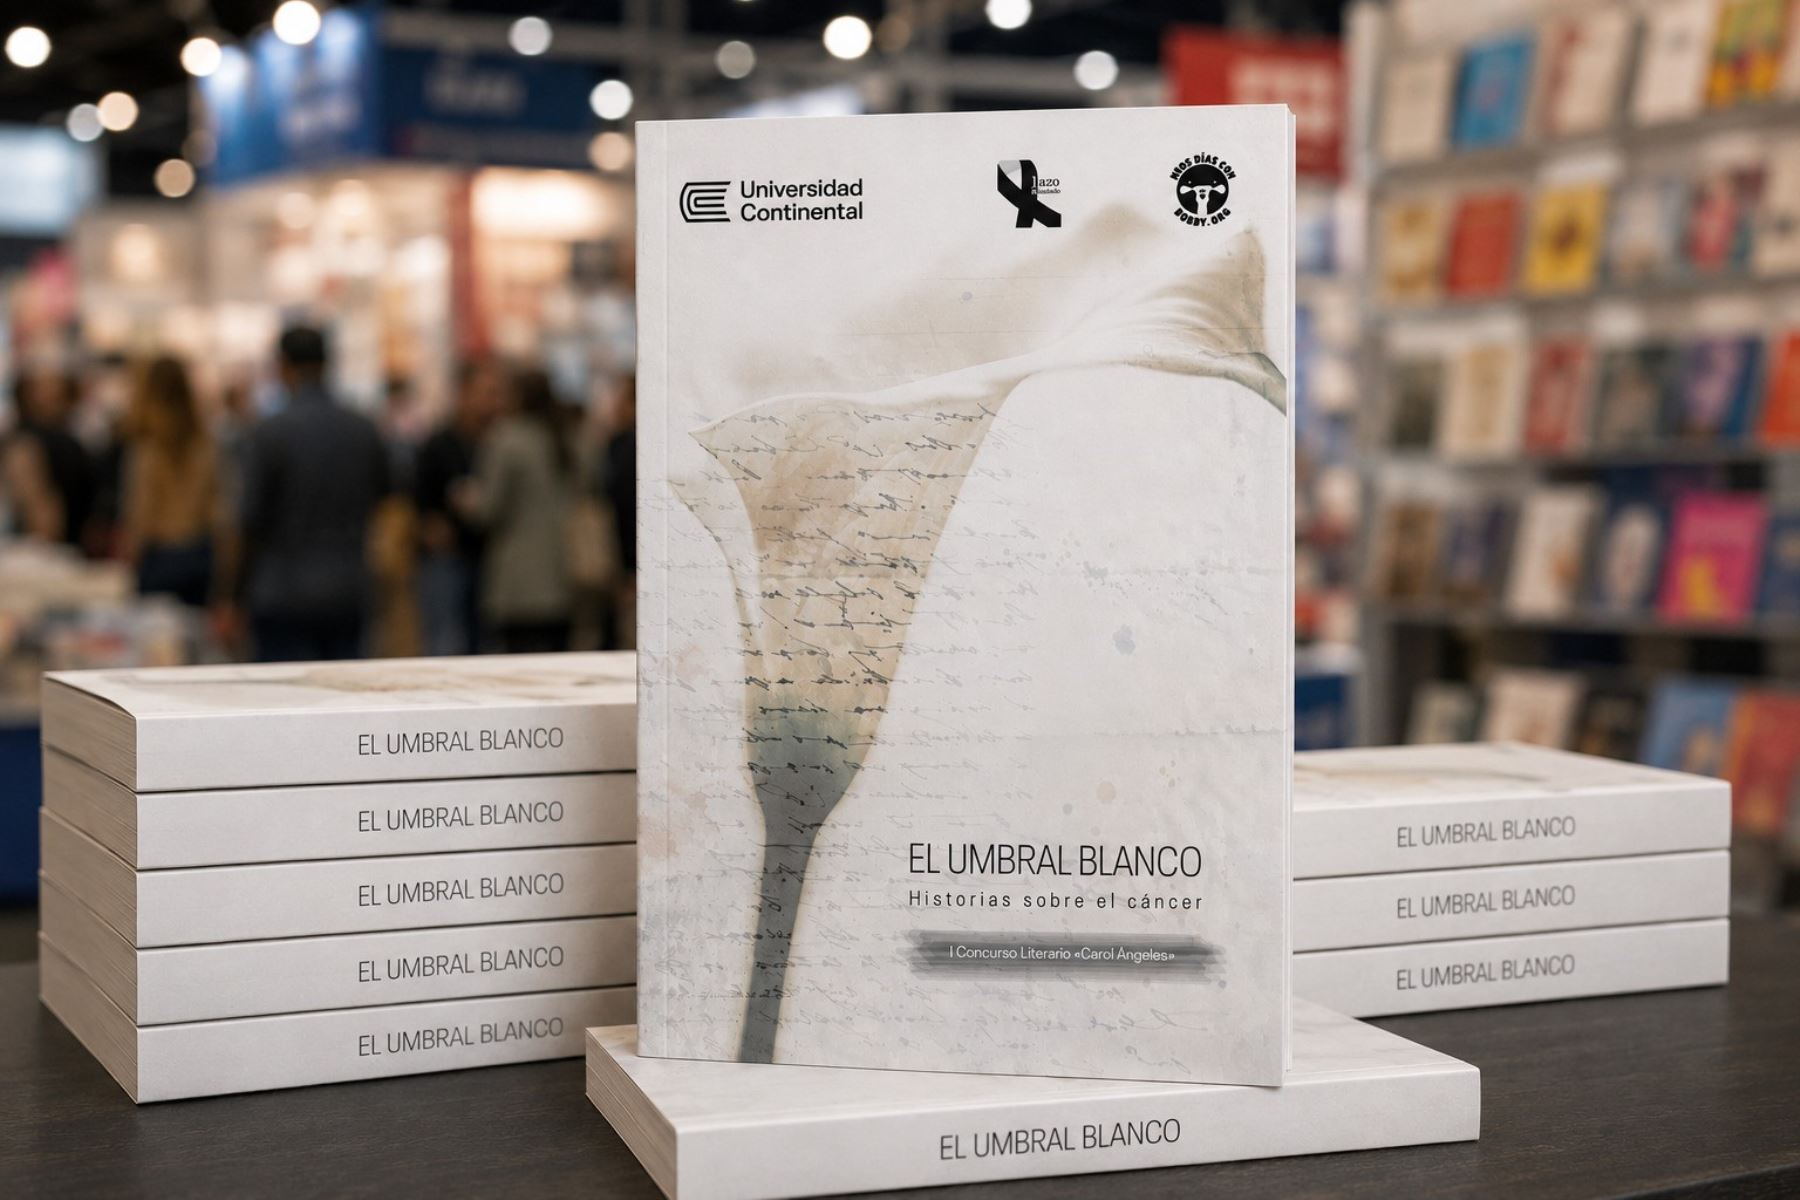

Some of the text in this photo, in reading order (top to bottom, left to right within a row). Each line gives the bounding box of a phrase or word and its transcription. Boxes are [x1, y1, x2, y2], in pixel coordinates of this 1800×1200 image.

[740, 178, 863, 198] Universidad
[740, 201, 863, 222] Continental
[359, 726, 565, 755] EL UMBRAL BLANCO
[359, 800, 565, 832] EL UMBRAL BLANCO
[1397, 816, 1576, 848] EL UMBRAL BLANCO
[909, 843, 1202, 877] EL UMBRAL BLANCO
[359, 872, 565, 906] EL UMBRAL BLANCO
[909, 890, 1203, 910] Historias sobre el cáncer
[1397, 885, 1576, 919] EL UMBRAL BLANCO
[359, 945, 565, 982] EL UMBRAL BLANCO
[956, 945, 1017, 959] Concurso
[1021, 946, 1071, 960] Literario
[1397, 953, 1576, 990] EL UMBRAL BLANCO
[359, 1016, 565, 1057] EL UMBRAL BLANCO
[940, 1117, 1181, 1160] EL UMBRAL BLANCO
